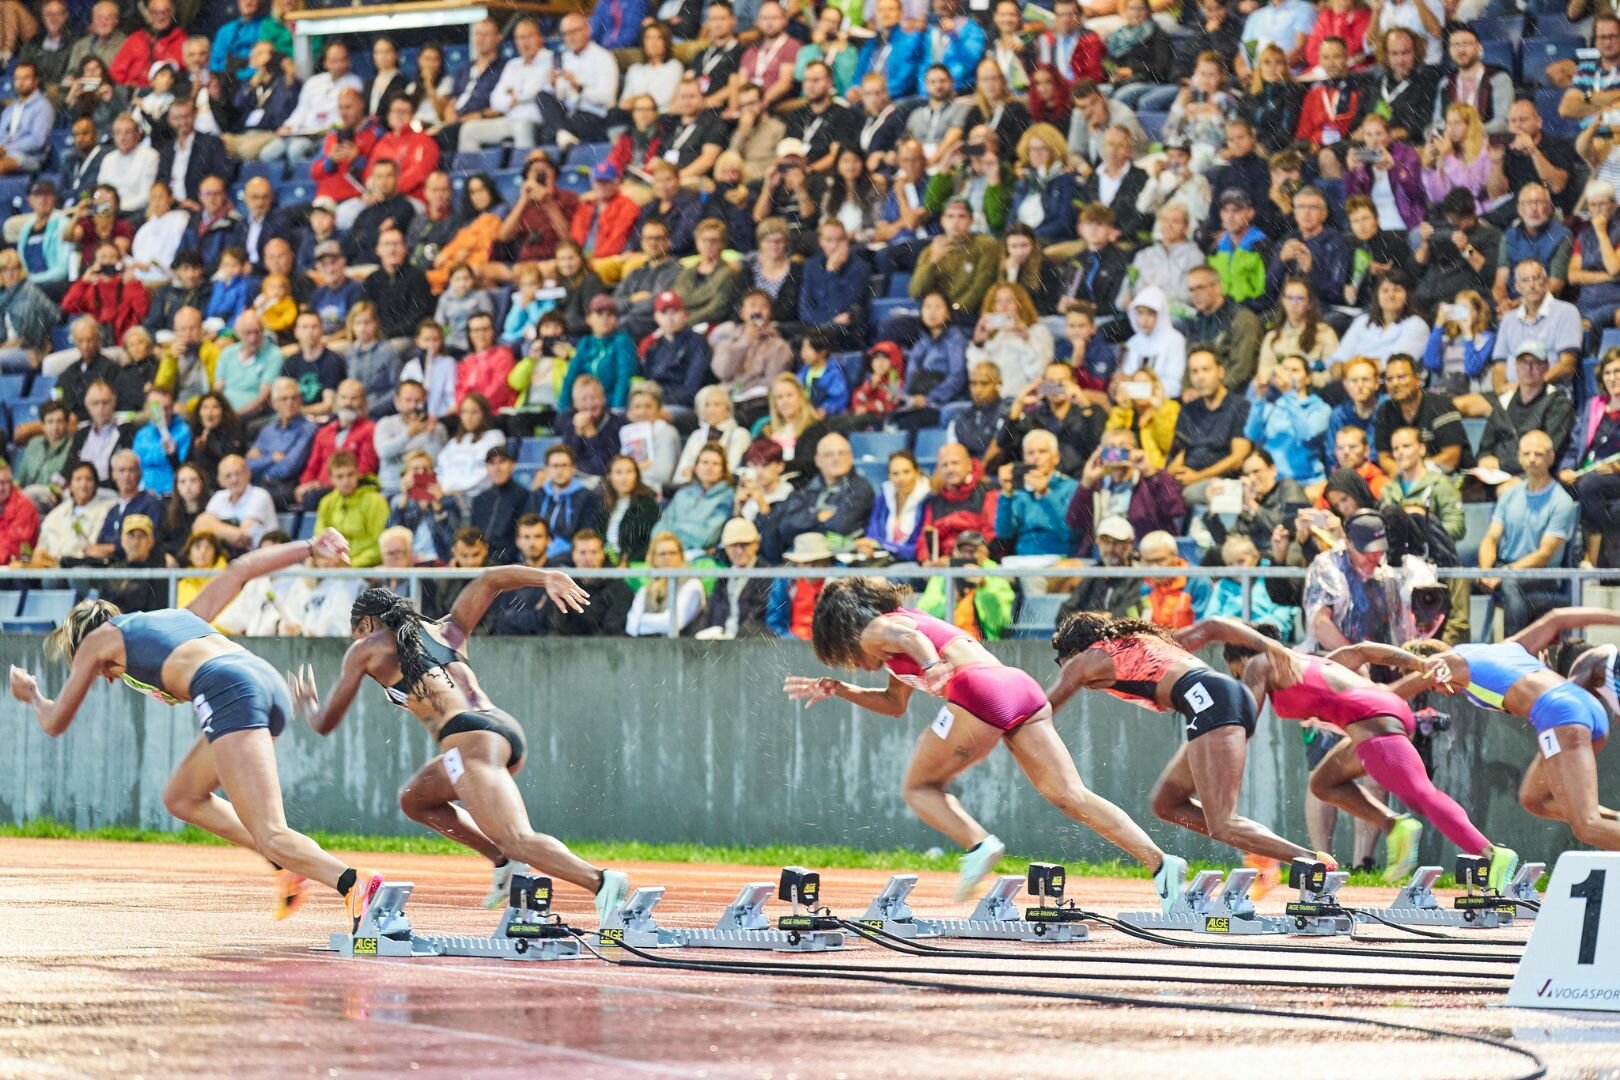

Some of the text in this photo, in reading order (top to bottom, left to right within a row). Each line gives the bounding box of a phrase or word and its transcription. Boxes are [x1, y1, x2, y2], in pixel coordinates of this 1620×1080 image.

[1193, 690, 1204, 705] 5
[1206, 918, 1229, 928] ALGE
[1570, 869, 1607, 965] 1
[354, 938, 377, 949] ALGE
